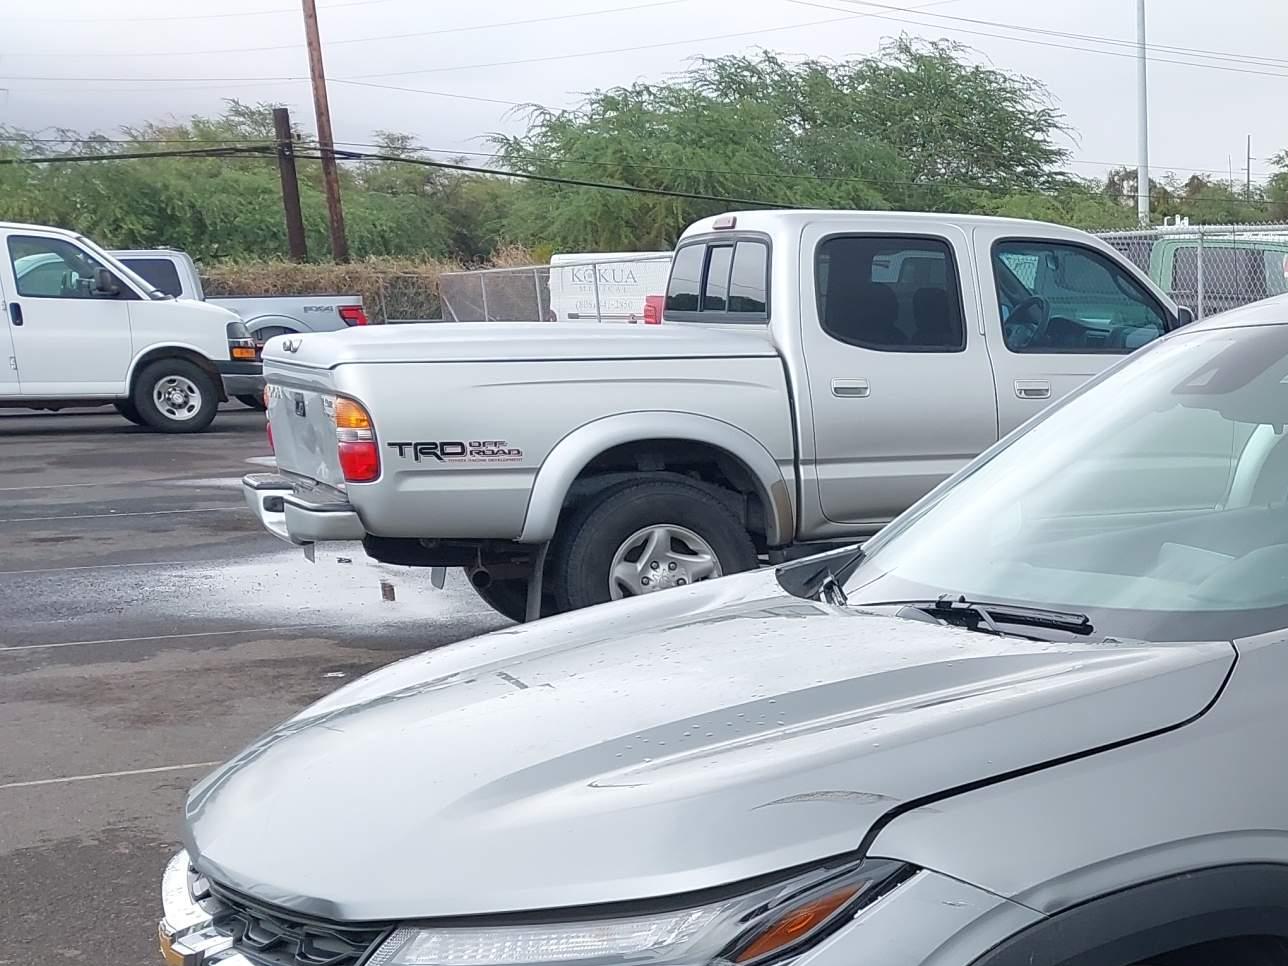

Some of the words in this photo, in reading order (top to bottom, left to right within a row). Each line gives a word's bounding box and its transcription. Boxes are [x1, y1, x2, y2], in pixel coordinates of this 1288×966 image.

[571, 267, 638, 284] KOKUA
[387, 441, 467, 463] TRD
[468, 440, 508, 449] OFF
[468, 448, 523, 458] ROAD
